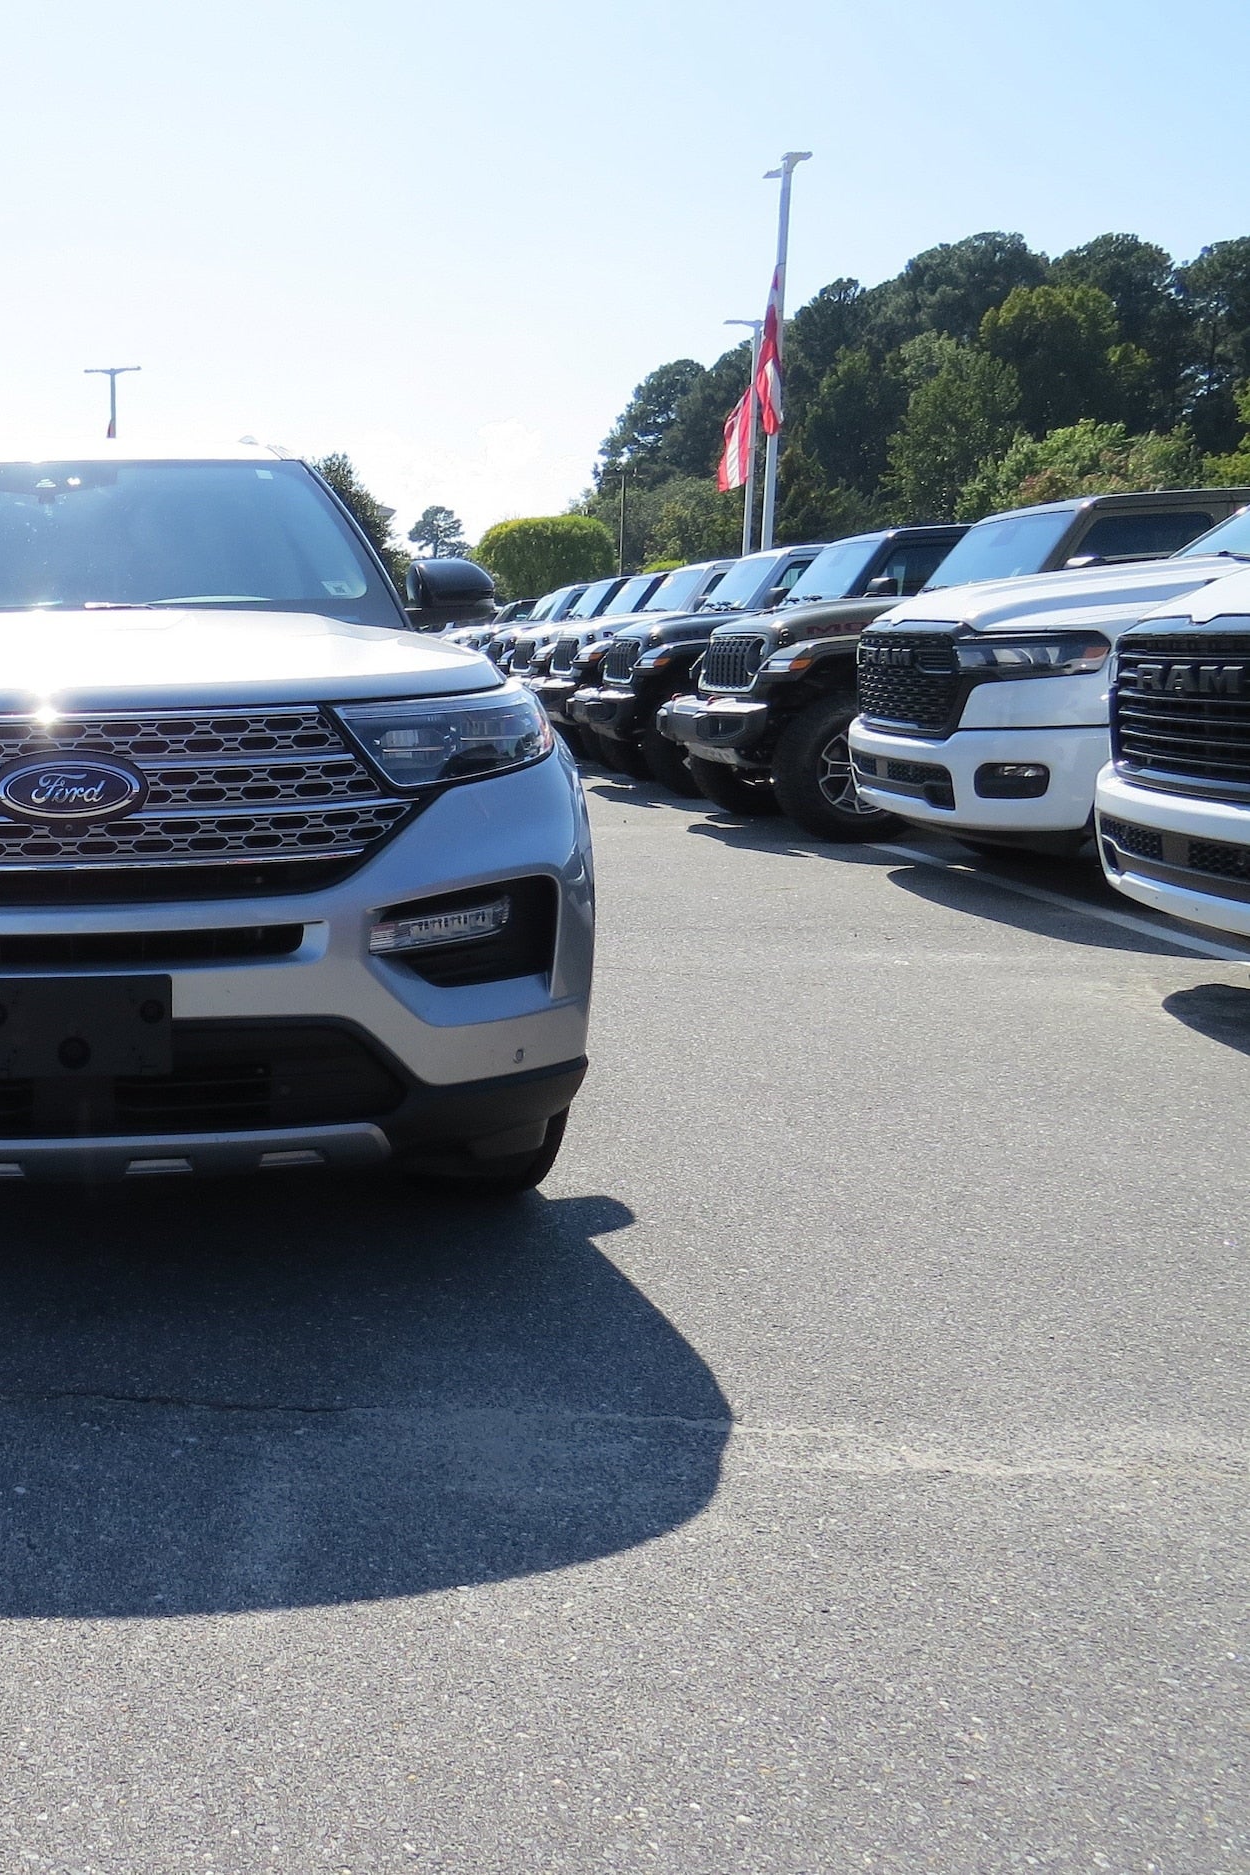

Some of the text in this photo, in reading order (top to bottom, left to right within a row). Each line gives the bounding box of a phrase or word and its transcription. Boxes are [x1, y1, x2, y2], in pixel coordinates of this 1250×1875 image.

[865, 647, 911, 665] RAM
[1136, 663, 1244, 693] RAM
[31, 773, 106, 804] Ford
